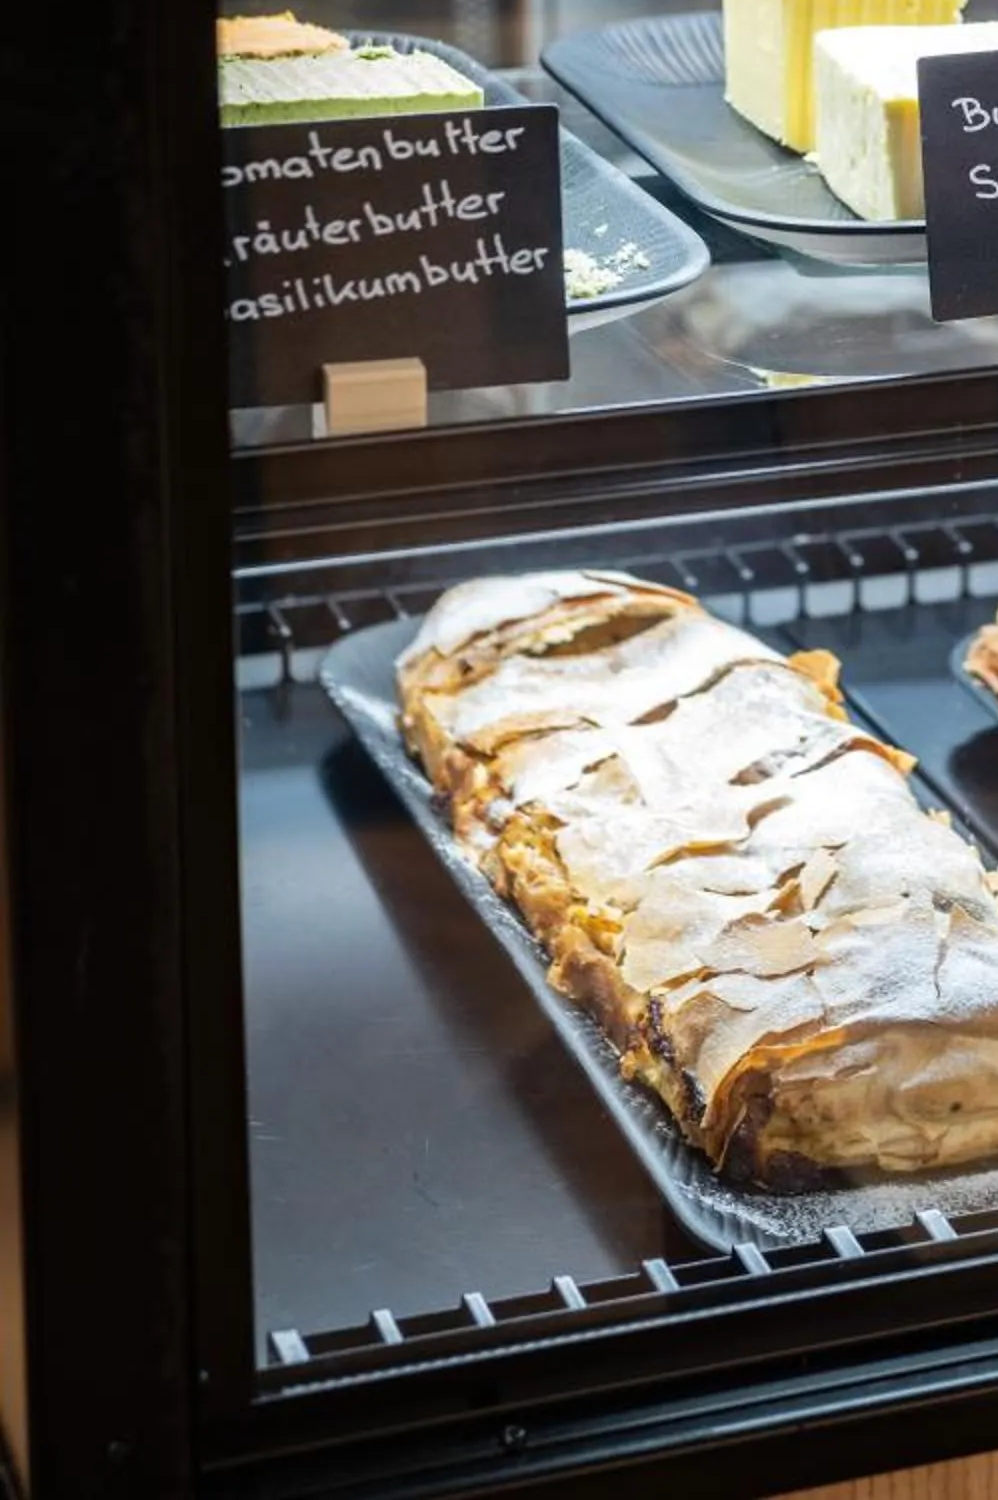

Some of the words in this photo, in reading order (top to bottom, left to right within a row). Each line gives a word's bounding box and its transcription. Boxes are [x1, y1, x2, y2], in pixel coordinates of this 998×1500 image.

[221, 117, 525, 187] omatenbutter
[224, 179, 506, 267] räuterbutter
[225, 233, 549, 322] asilikumbutter
